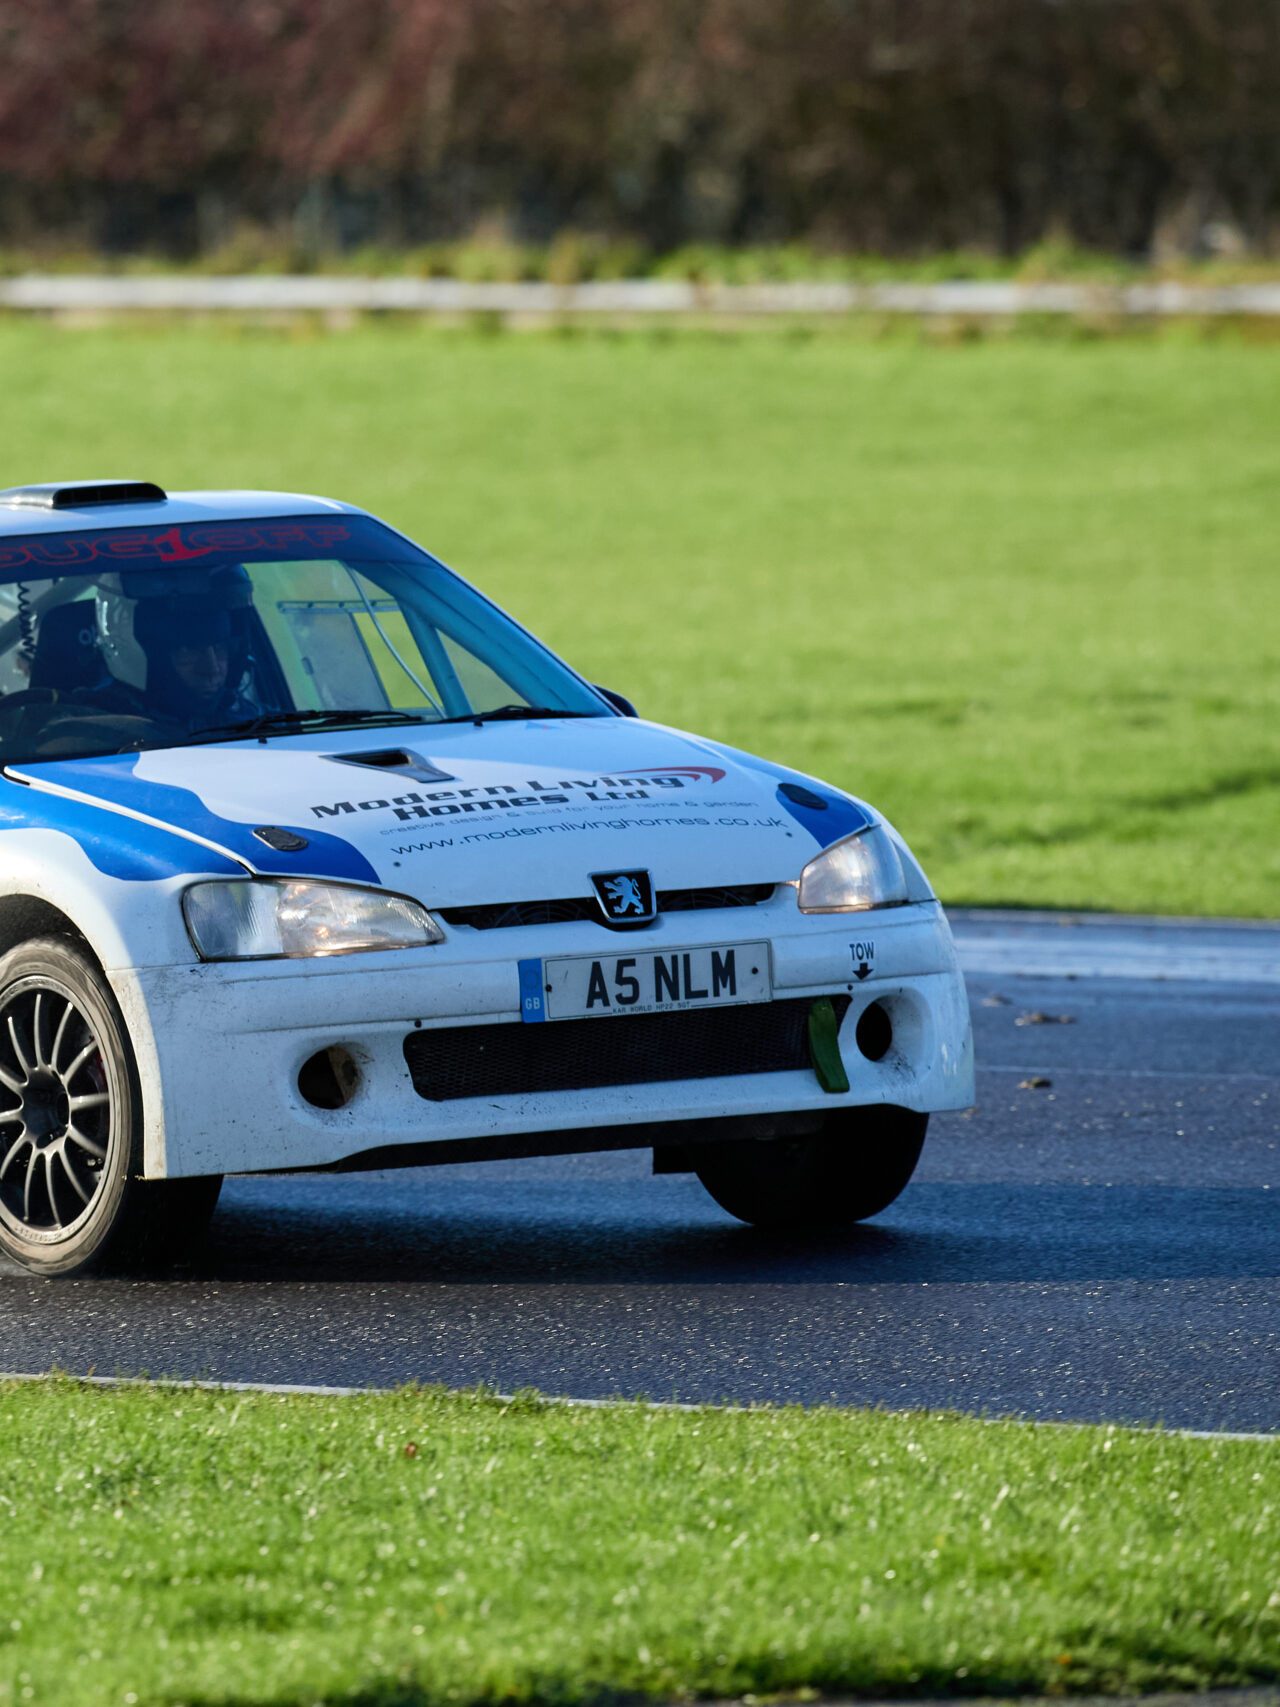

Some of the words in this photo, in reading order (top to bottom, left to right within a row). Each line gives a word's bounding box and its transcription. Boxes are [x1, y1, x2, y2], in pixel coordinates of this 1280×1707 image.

[310, 784, 518, 818] Modern
[526, 776, 686, 792] Living
[392, 794, 569, 821] Homes
[585, 789, 651, 802] Ltd
[379, 821, 446, 836] creative
[449, 813, 502, 828] design
[565, 804, 589, 813] for
[591, 803, 628, 813] your
[636, 799, 682, 809] home
[703, 800, 759, 810] garden
[391, 816, 789, 855] www.modernlivinghomes.co.uk
[849, 941, 874, 961] TOW
[586, 957, 640, 1009] A5
[654, 949, 737, 1003] NLM
[525, 996, 541, 1011] GB
